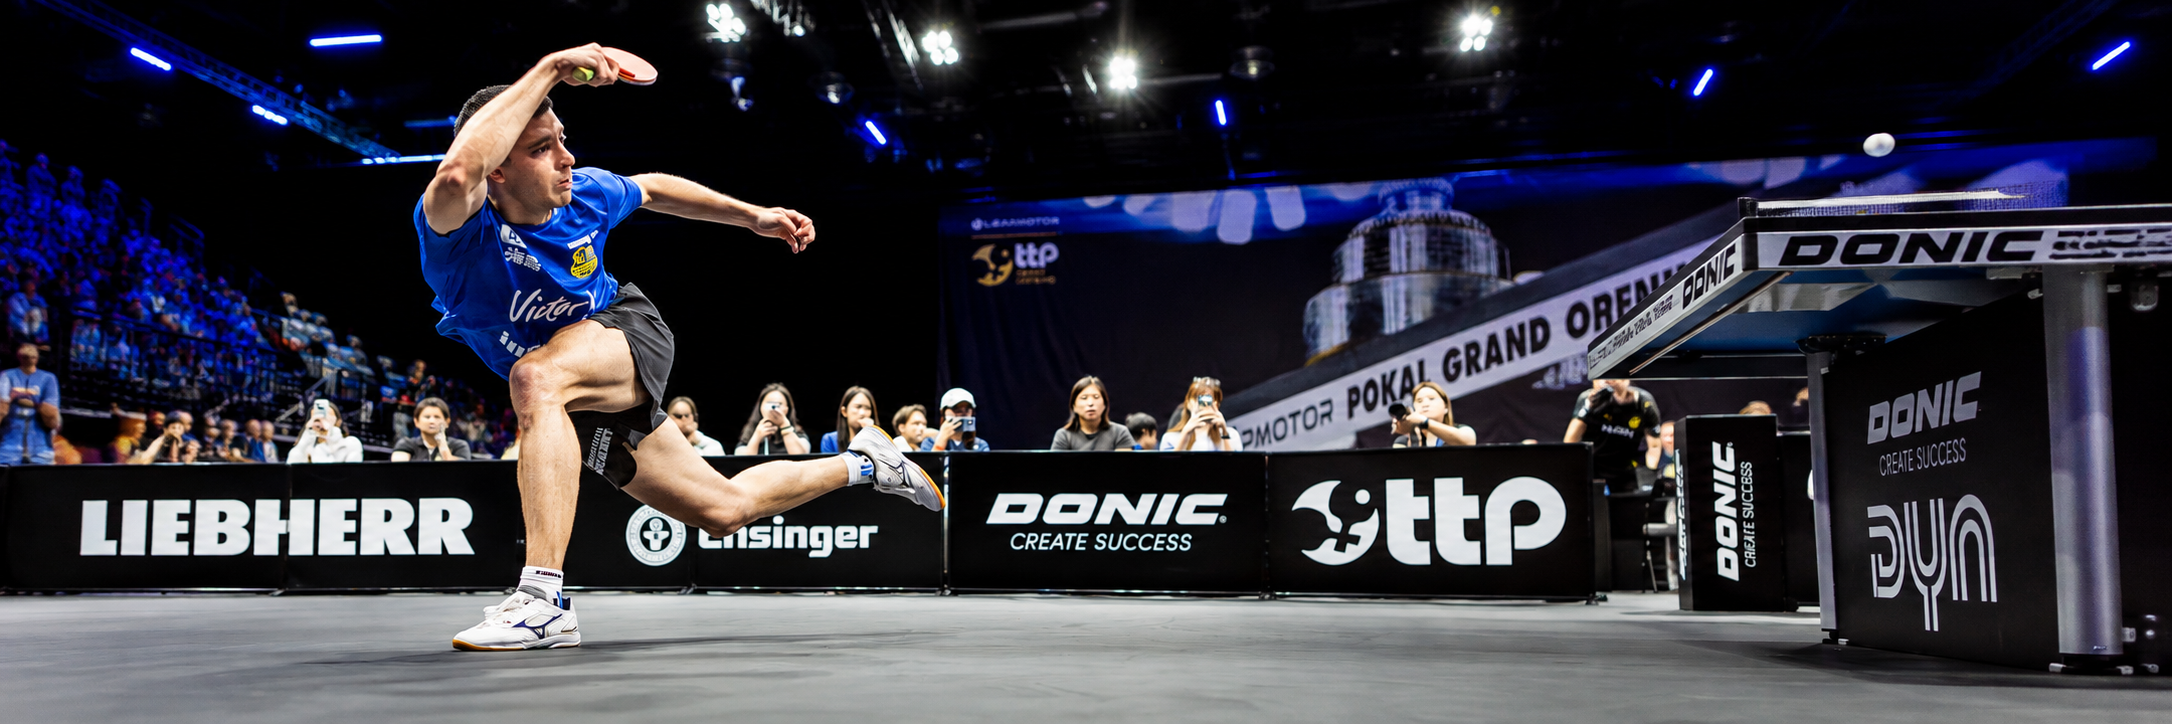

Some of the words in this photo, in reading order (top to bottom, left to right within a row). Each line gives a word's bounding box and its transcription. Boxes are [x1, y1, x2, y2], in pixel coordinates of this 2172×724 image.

[1682, 242, 1736, 310] DONIC
[1777, 231, 2044, 266] DONIC
[509, 288, 589, 322] Victor
[1235, 398, 1334, 449] PMOTOR
[1347, 358, 1431, 419] POKAL
[1442, 315, 1551, 384] GRAND
[1565, 261, 1687, 339] OREN
[1867, 371, 1981, 445] DONIC
[1879, 448, 1914, 477] CREATE
[1916, 437, 1967, 470] SUCCESS
[80, 498, 475, 556] LIEBHERR
[986, 493, 1228, 525] DONIC
[1385, 476, 1567, 566] ttp
[1712, 441, 1740, 582] DONIC
[1010, 532, 1089, 551] CREATE
[1094, 532, 1193, 551] SUCCESS
